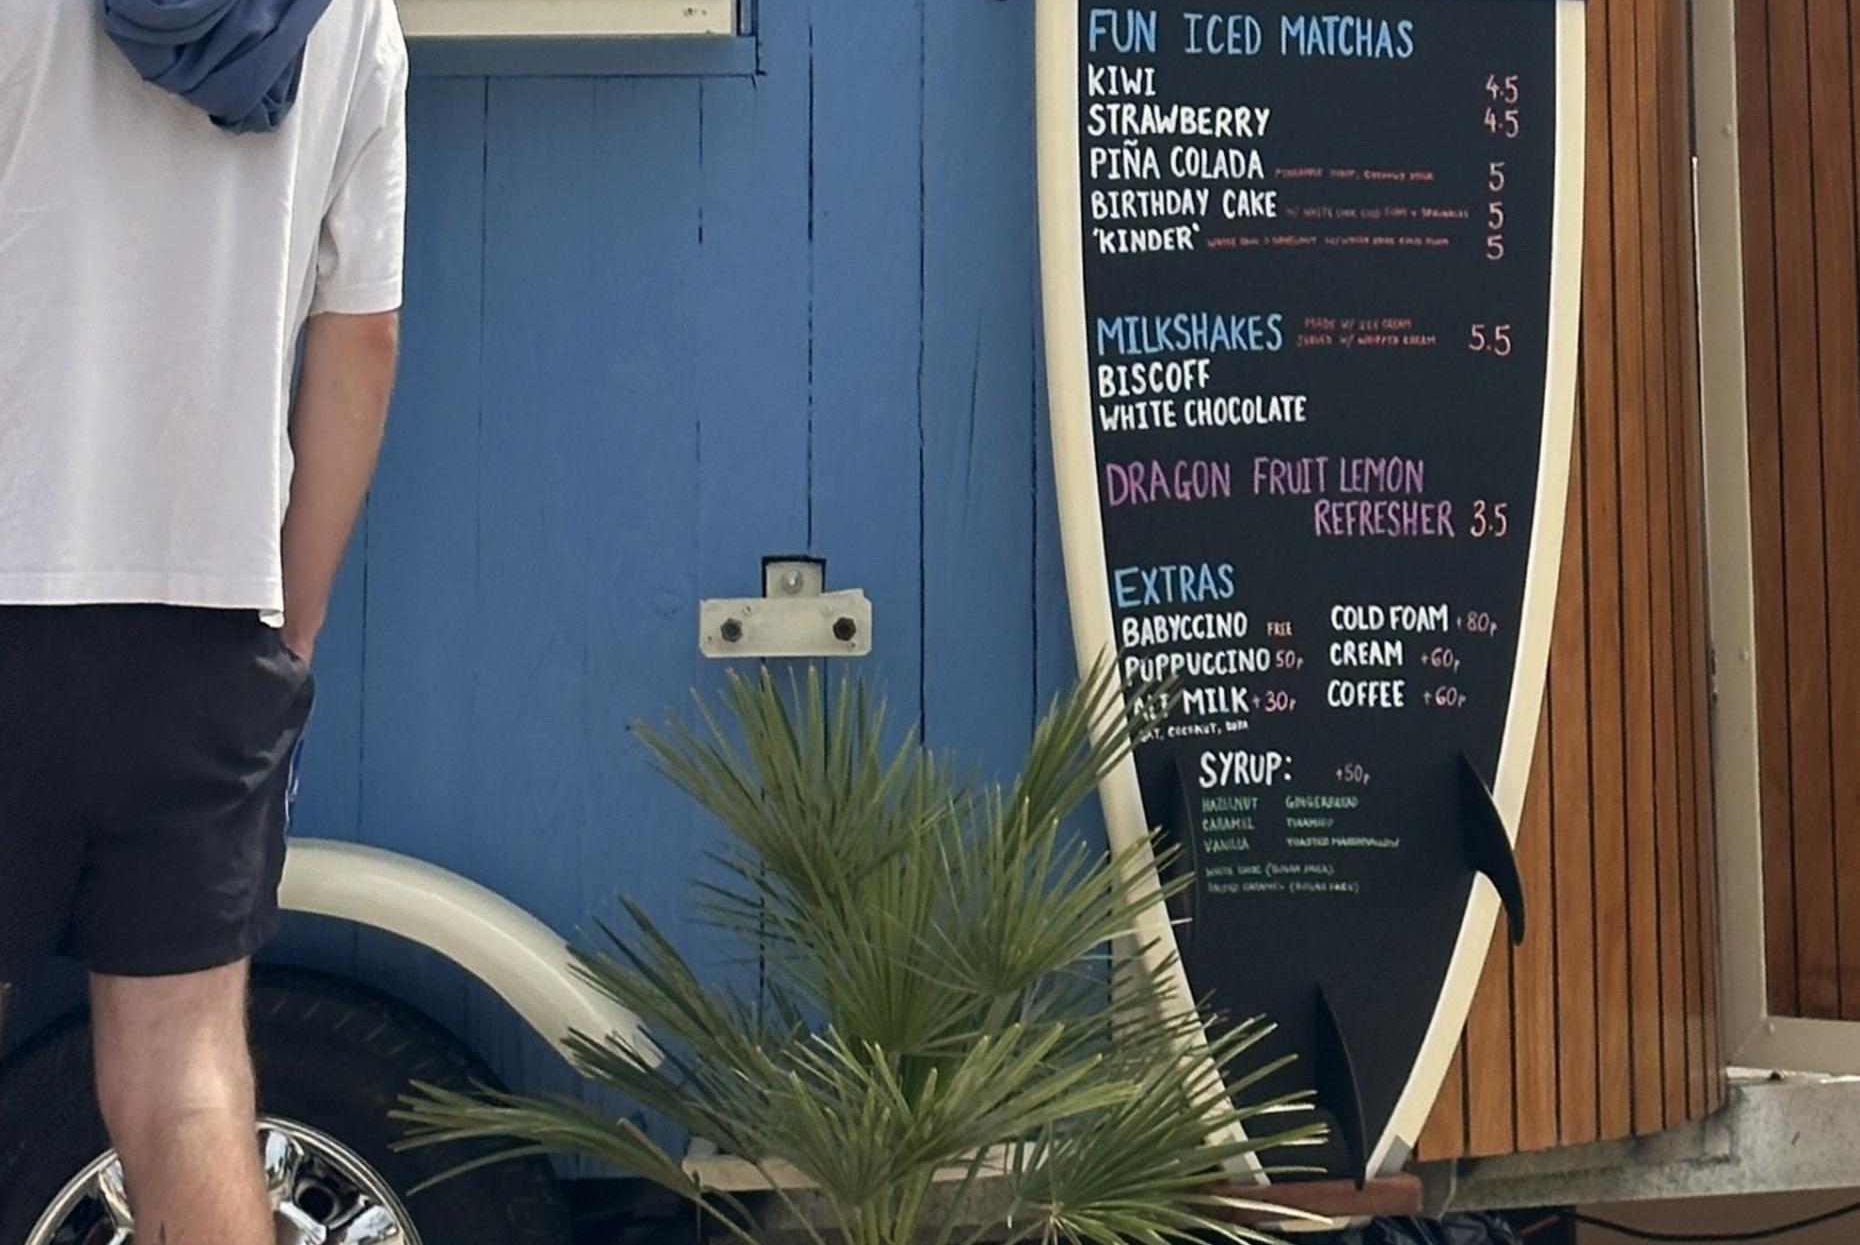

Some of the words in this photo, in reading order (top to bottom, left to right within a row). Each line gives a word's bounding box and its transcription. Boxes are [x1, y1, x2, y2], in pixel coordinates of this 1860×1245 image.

[1090, 9, 1156, 52] FUN
[1184, 13, 1261, 54] ICED
[1281, 16, 1413, 58] MATCHAS
[1088, 64, 1155, 96] KIWI
[1486, 75, 1517, 103] 4.5
[1088, 103, 1269, 137] STRAWBERRY
[1485, 108, 1518, 137] 4.5
[1091, 139, 1160, 179] PIÑA
[1171, 146, 1264, 179] COLADA
[1489, 162, 1504, 191] 5
[1091, 188, 1208, 219] BIRTHDAY
[1223, 189, 1276, 218] CAKE
[1489, 202, 1503, 229] 5
[1487, 235, 1503, 259] 5
[1098, 313, 1282, 355] MILKSHAKES
[1469, 325, 1510, 355] 5.5
[1098, 359, 1209, 397] BISCOFF
[1099, 400, 1176, 431] WHITE
[1185, 396, 1306, 426] CHOCOLATE
[1106, 460, 1230, 506] DRAGON
[1254, 457, 1328, 494] FRUIT
[1340, 456, 1423, 493] LEMON
[1315, 499, 1454, 537] REFRESHER
[1471, 500, 1506, 537] 3.5
[1115, 563, 1234, 607] EXTRAS
[1123, 612, 1247, 647] BABYCCINO
[1266, 621, 1292, 637] FREE
[1331, 605, 1384, 630] COLD
[1390, 604, 1448, 632] FOAM
[1125, 648, 1270, 686] PUPPUCCINO
[1330, 640, 1402, 666] CREAM
[1182, 687, 1249, 715] MILK
[1328, 680, 1404, 707] COFFEE
[1199, 751, 1291, 788] SYRUP:
